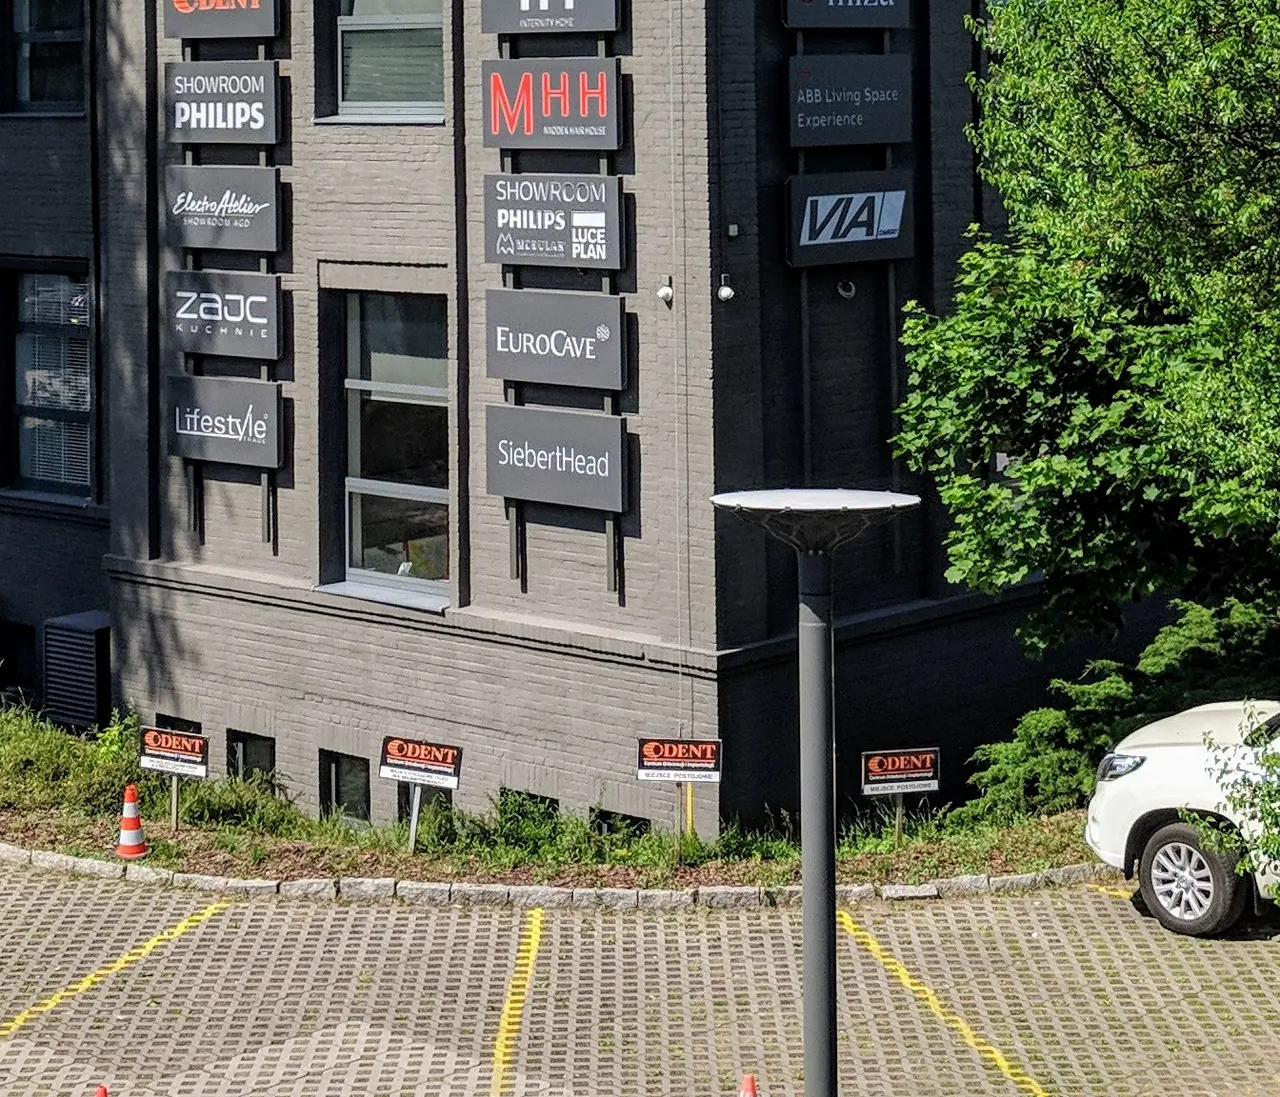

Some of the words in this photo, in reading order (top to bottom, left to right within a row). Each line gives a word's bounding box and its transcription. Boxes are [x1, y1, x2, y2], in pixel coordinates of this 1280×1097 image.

[174, 75, 264, 94] SHOWROOM
[490, 71, 607, 135] MHH
[797, 88, 822, 103] ABB
[825, 87, 861, 106] Living
[864, 87, 899, 105] Space
[174, 101, 265, 130] PHILIPS
[797, 111, 863, 129] Experience
[495, 180, 606, 203] SHOWROOM
[497, 208, 566, 230] PHILIPS
[808, 195, 876, 241] VIA
[572, 228, 606, 243] LUCE
[572, 243, 606, 259] PLAN
[175, 323, 268, 338] KUCHNIE
[175, 404, 267, 442] Lifestyle
[498, 439, 609, 477] SiebertHead
[145, 731, 203, 752] ODENT
[387, 739, 457, 763] ODENT
[643, 741, 716, 759] ODENT
[868, 754, 935, 772] ODENT
